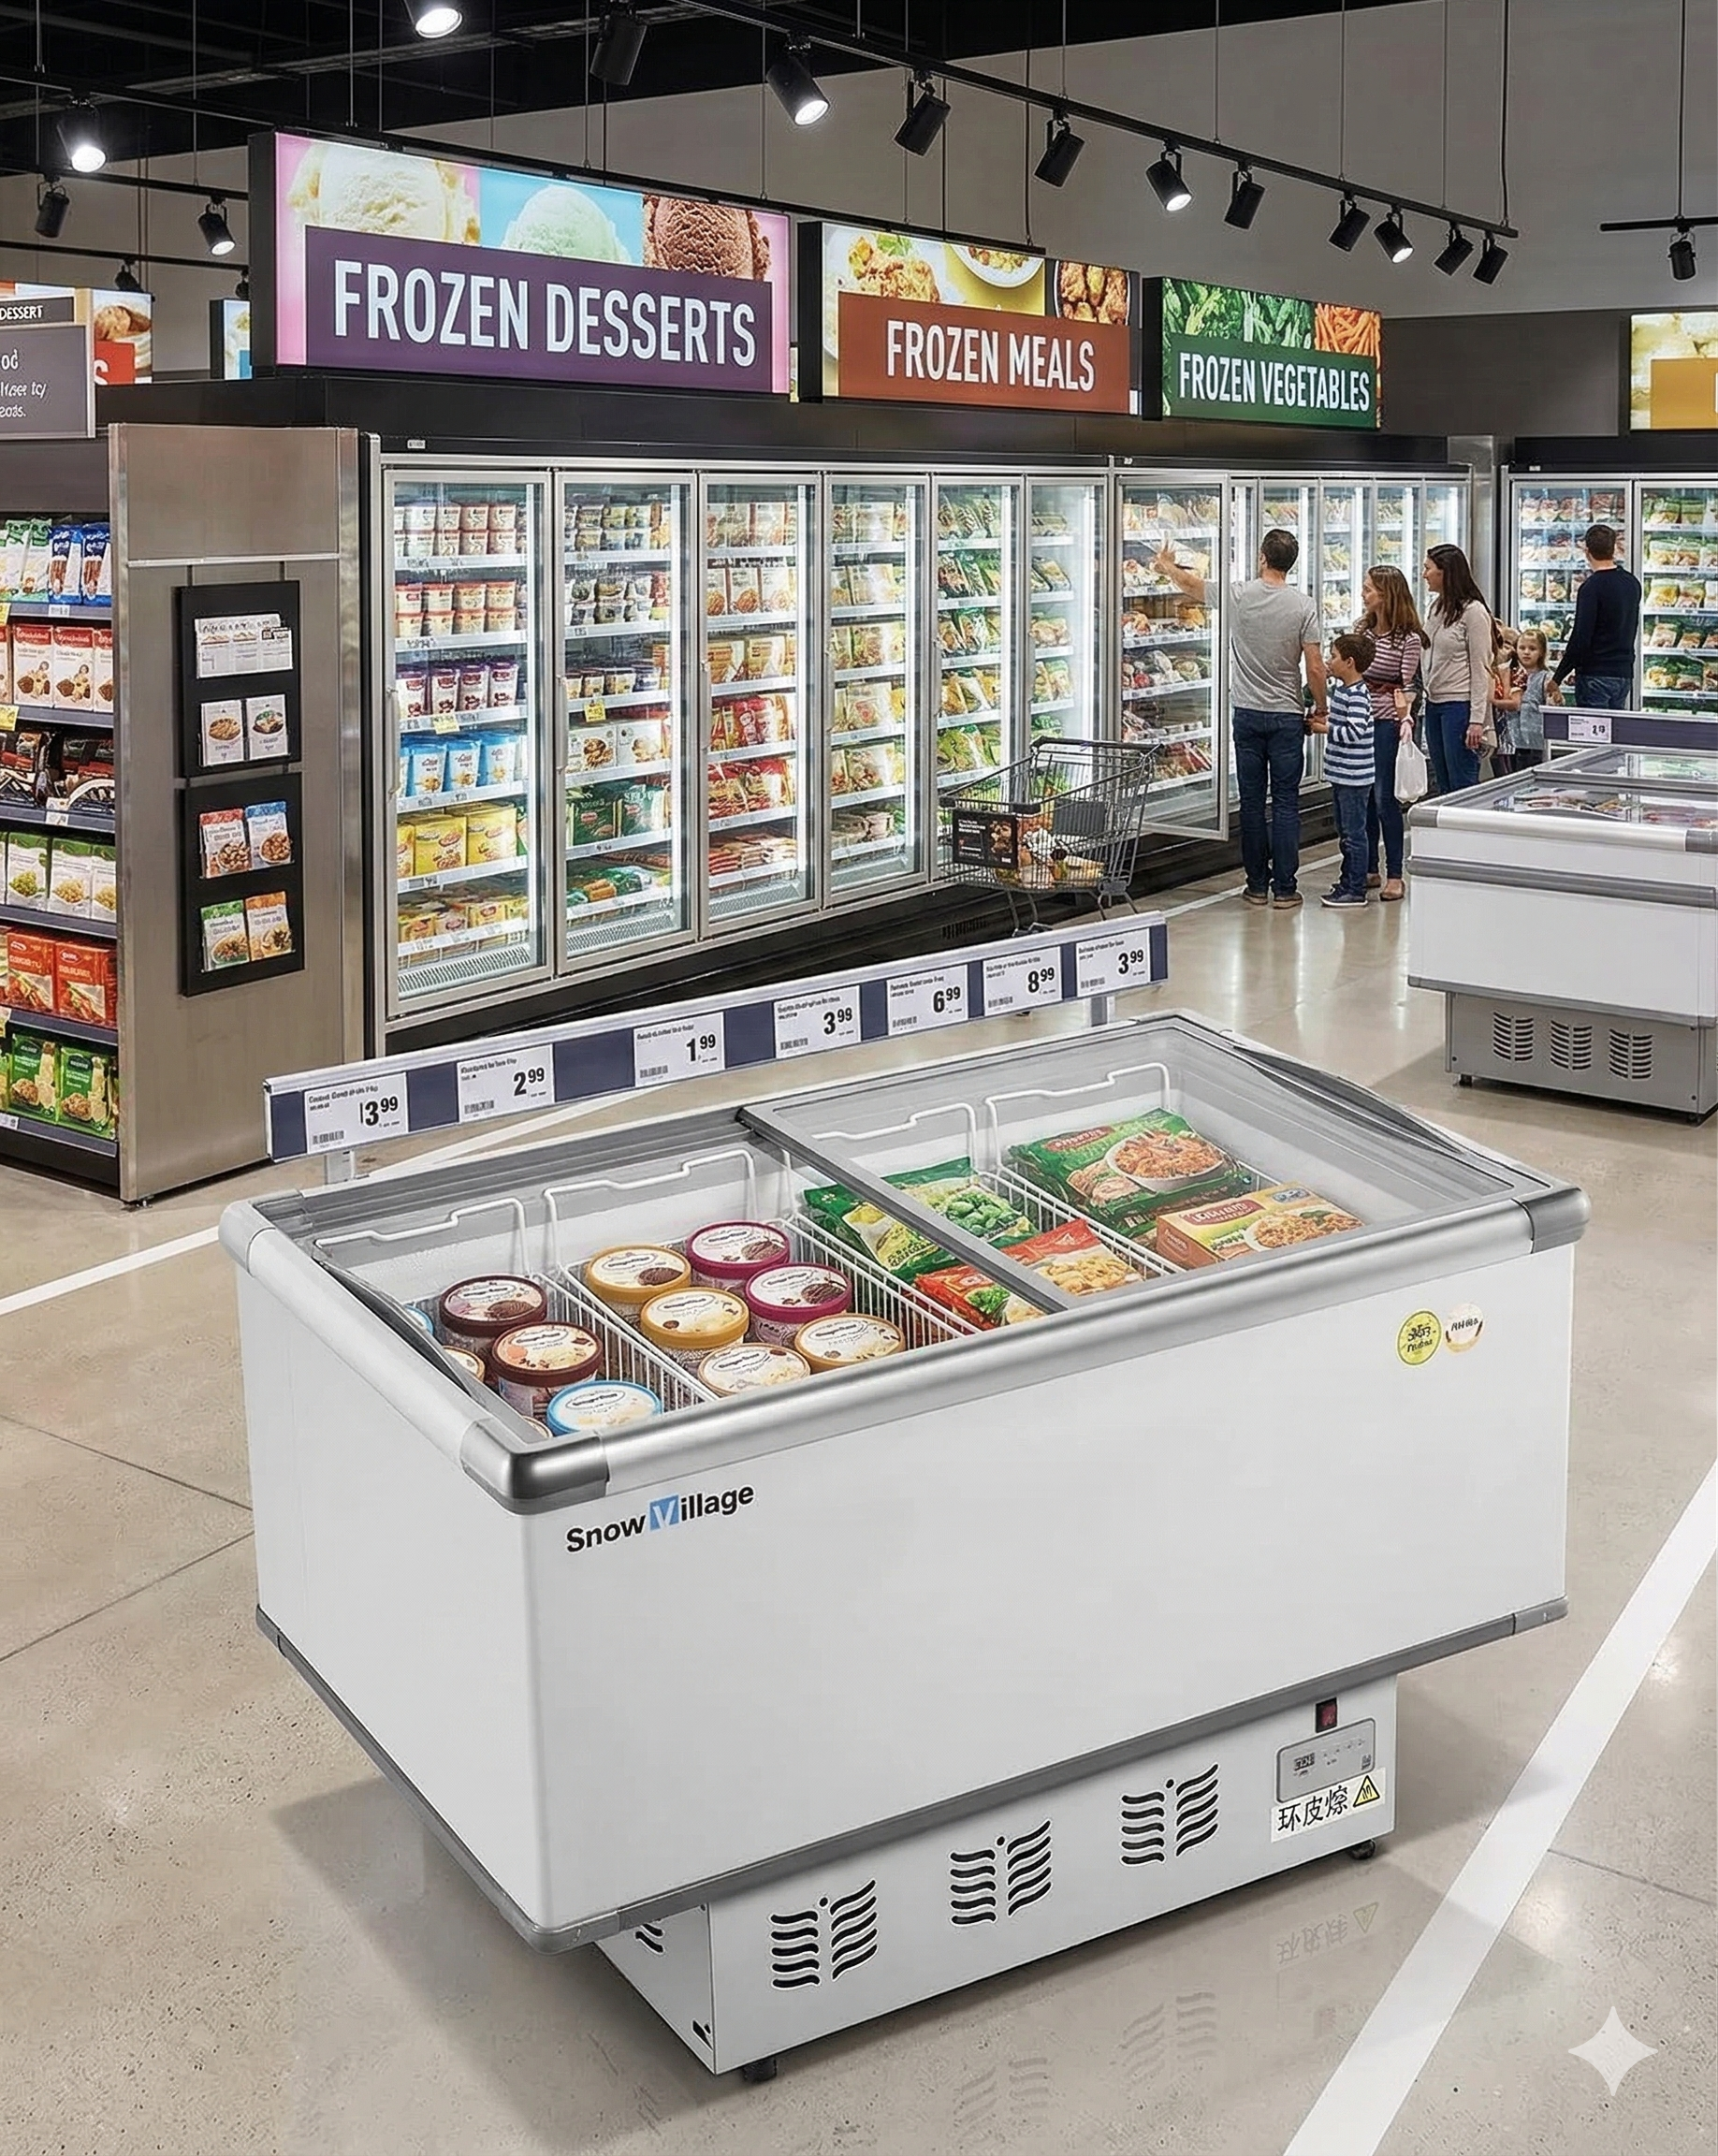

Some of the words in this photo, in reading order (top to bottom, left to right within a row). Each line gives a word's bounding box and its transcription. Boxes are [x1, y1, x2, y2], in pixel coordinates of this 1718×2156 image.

[334, 259, 529, 350] FROZEN
[546, 284, 757, 368] DESSERTS
[887, 320, 999, 384] FROZEN
[1010, 333, 1095, 392] MEALS
[1179, 352, 1258, 404] FROZEN
[1260, 361, 1371, 413] VEGETABLES
[566, 1513, 647, 1553] Snow
[652, 1485, 754, 1528] Village
